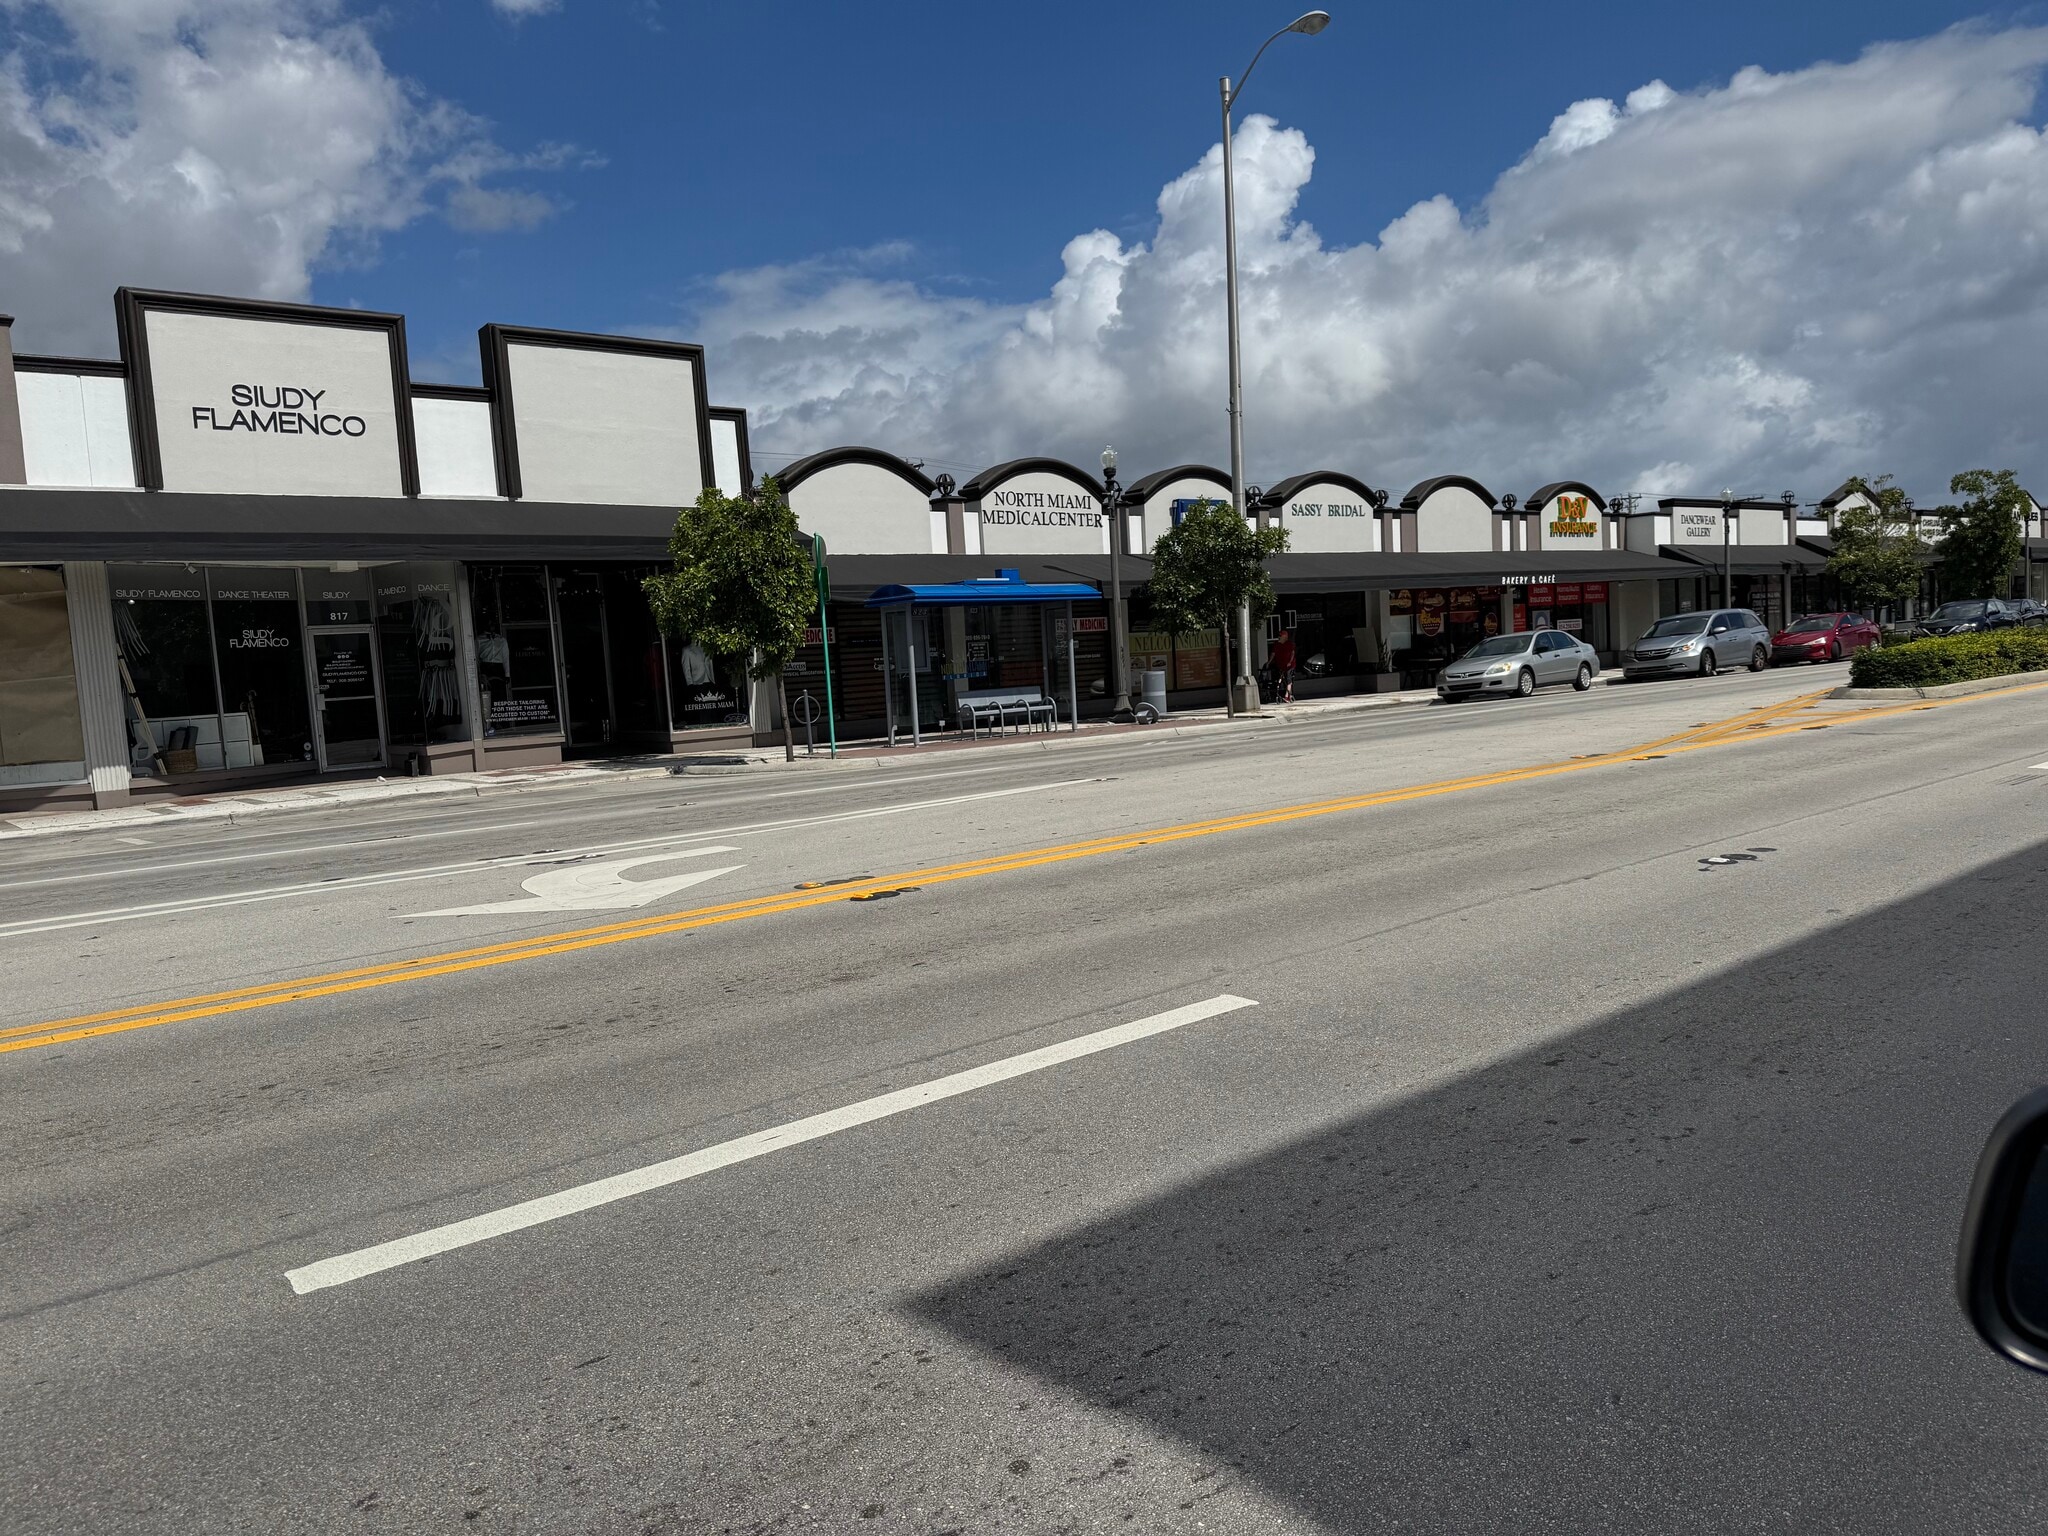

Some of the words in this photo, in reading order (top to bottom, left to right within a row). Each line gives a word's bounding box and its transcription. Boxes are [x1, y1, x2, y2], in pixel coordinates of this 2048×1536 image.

[231, 384, 326, 411] SIUDY
[192, 406, 366, 437] FLAMENCO
[994, 491, 1044, 507] NORTH
[1047, 493, 1092, 510] MIAMI
[1292, 503, 1322, 517] SASSY
[1328, 504, 1366, 518] BRIDAL
[1558, 496, 1590, 520] D&V
[1681, 514, 1717, 526] DANCEWEAR
[1551, 521, 1598, 535] INSURANCE
[1687, 527, 1712, 537] GALLERY
[1501, 576, 1529, 585] BAKERY
[377, 585, 407, 596] FLAMENCO
[417, 583, 450, 592] DANCE
[116, 589, 145, 598] SIUDY
[148, 589, 201, 598] FLAMENCO
[218, 590, 249, 599] DANCE
[251, 591, 290, 599] THEATER
[322, 591, 351, 600] SIUDY
[329, 612, 348, 621] 817
[1080, 618, 1105, 631] MEDICINE
[242, 629, 275, 639] SIUDY
[229, 638, 289, 649] FLAMENCO
[1135, 636, 1171, 651] NELCO
[684, 702, 717, 711] LEPREMIER
